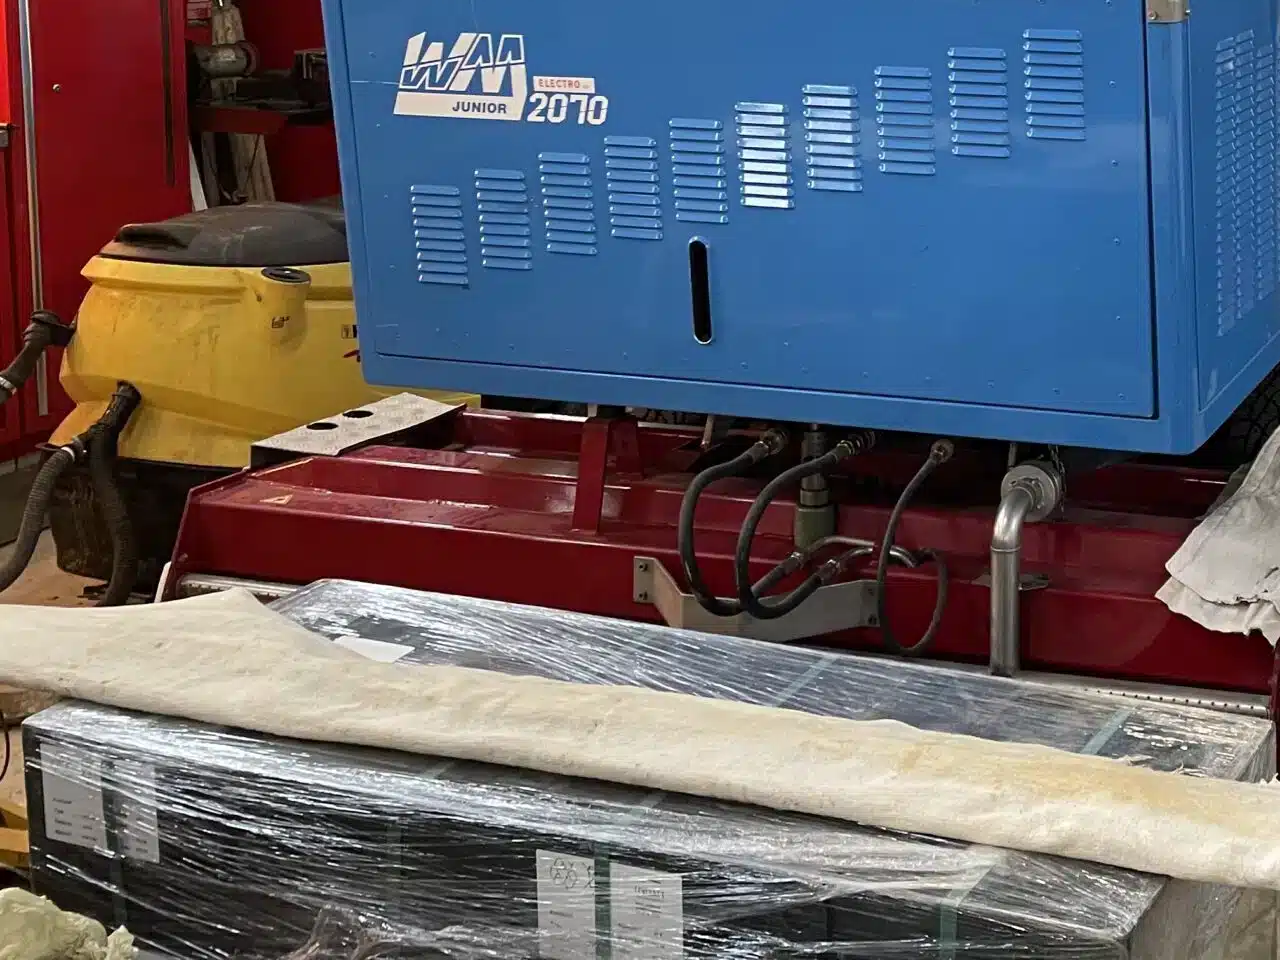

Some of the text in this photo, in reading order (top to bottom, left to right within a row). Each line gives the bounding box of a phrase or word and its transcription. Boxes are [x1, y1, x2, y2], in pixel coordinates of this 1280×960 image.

[538, 78, 581, 89] ELECTRO
[452, 101, 507, 114] JUNIOR
[527, 92, 608, 125] 2070
